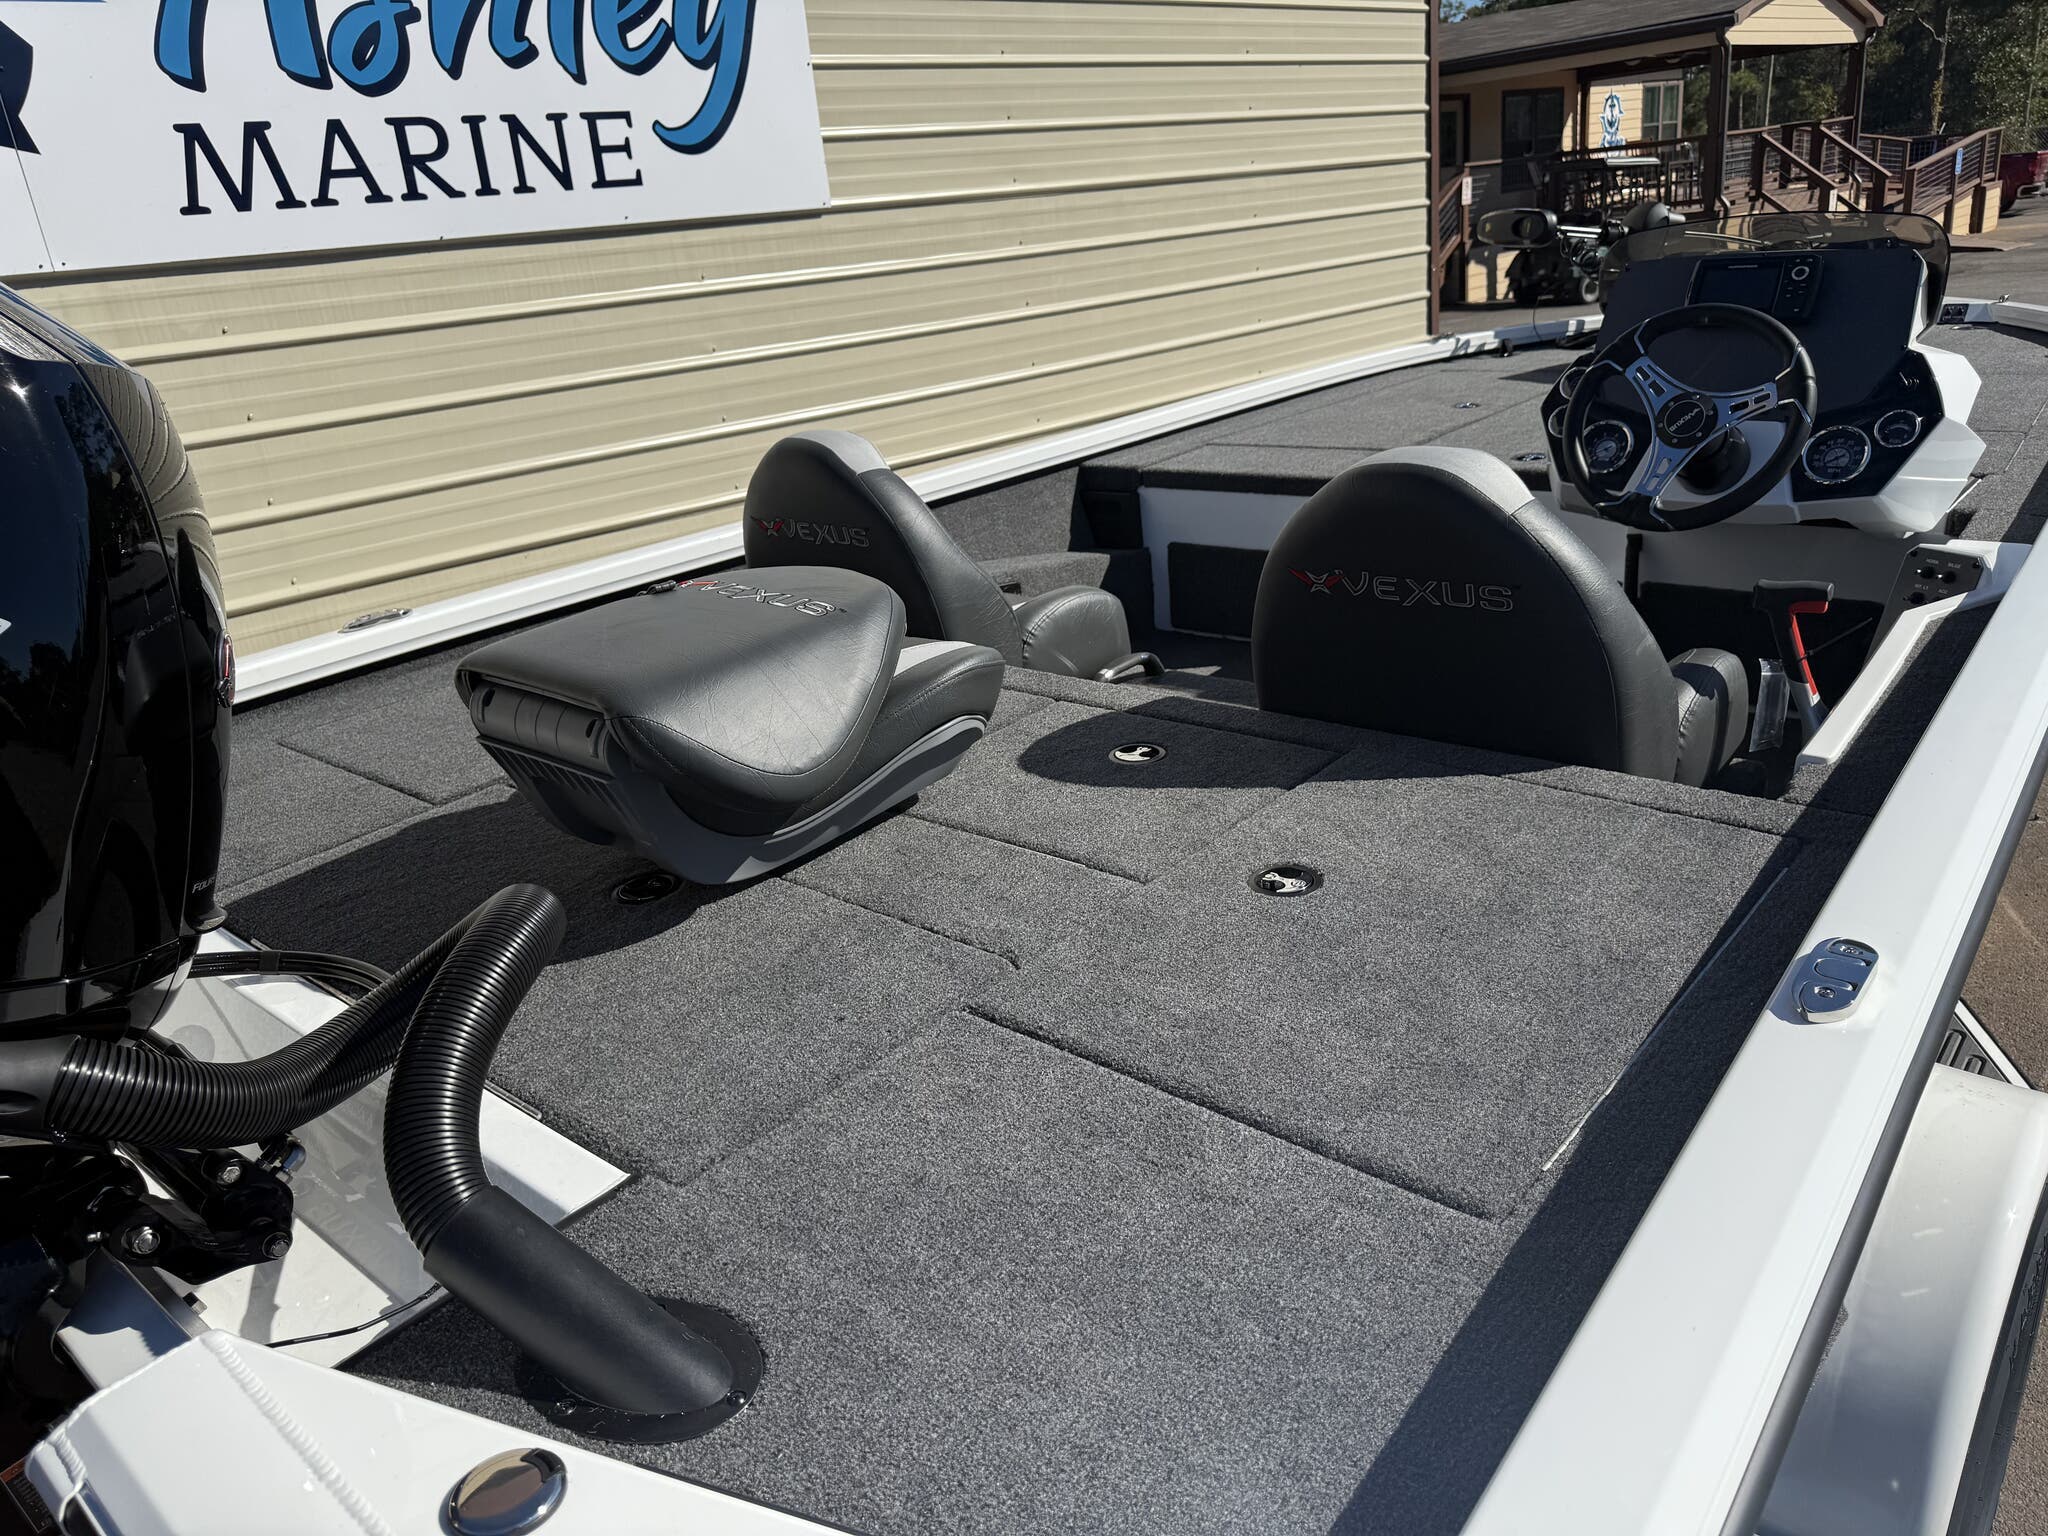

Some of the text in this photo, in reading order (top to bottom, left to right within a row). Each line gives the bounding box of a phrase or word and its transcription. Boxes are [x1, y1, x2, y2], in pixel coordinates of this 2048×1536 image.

[173, 110, 644, 216] MARINE
[784, 518, 870, 548] VEXUS
[700, 581, 836, 617] VEXUS
[1342, 571, 1514, 613] VEXUS
